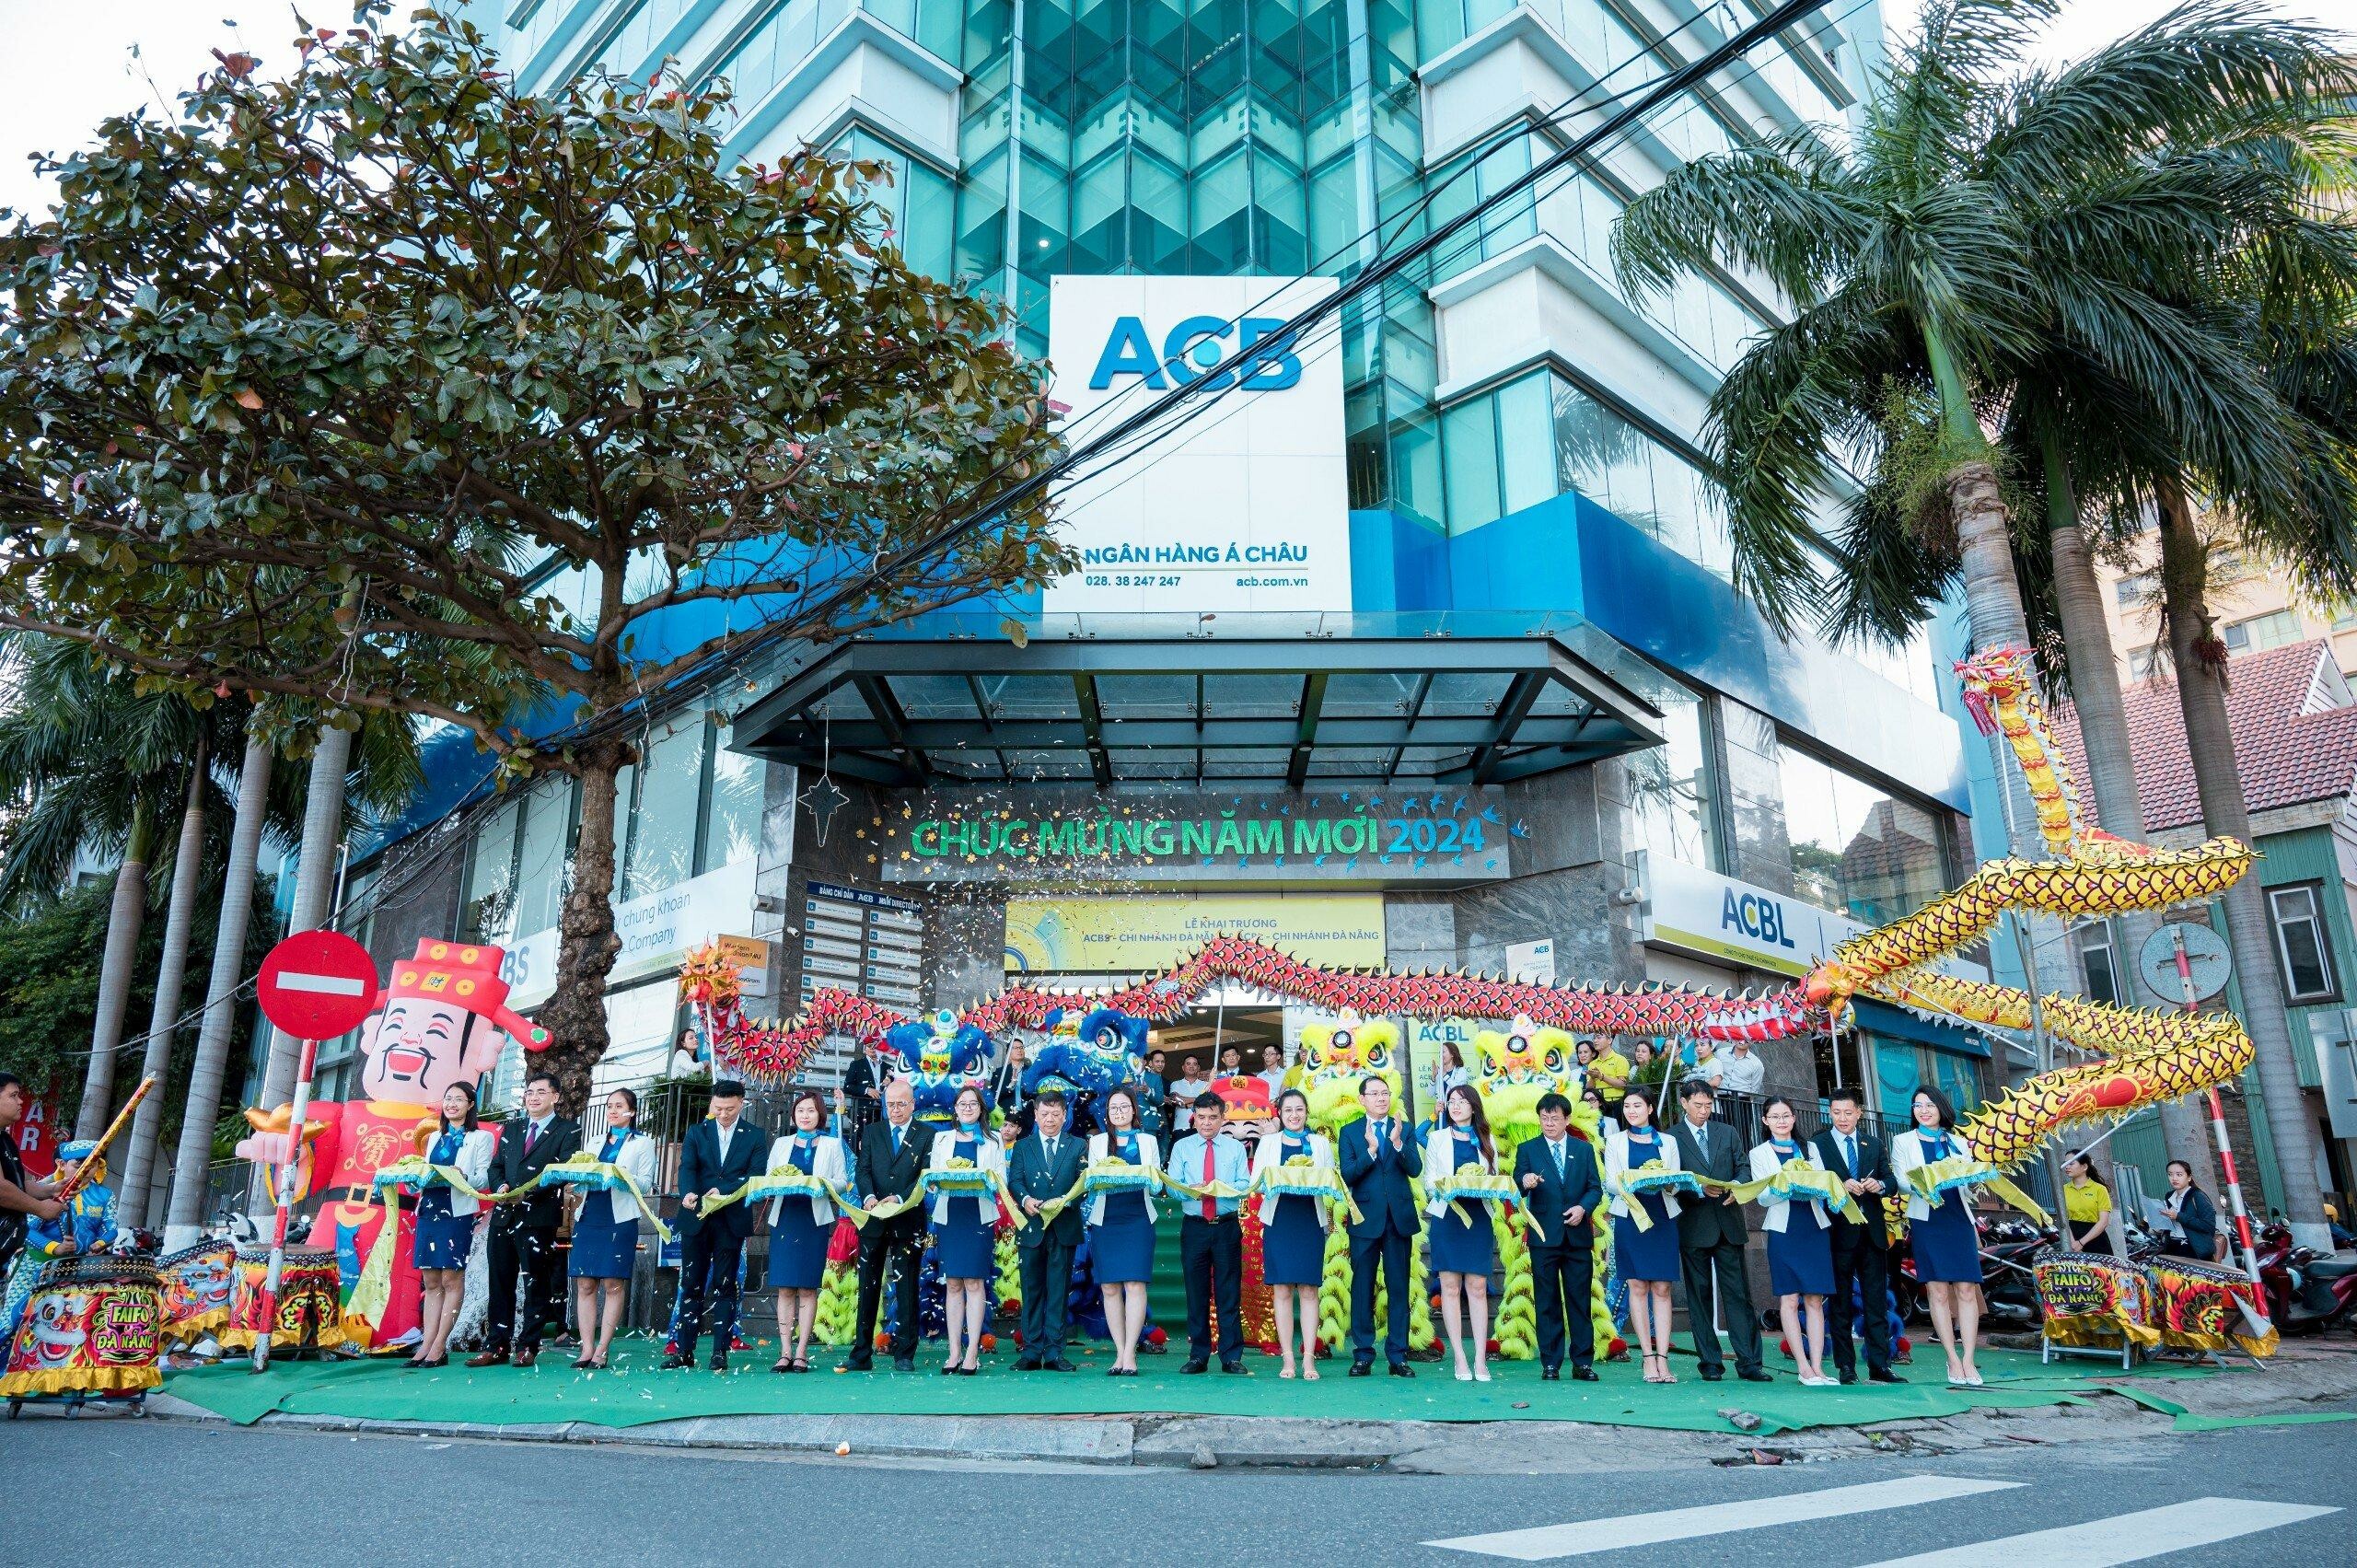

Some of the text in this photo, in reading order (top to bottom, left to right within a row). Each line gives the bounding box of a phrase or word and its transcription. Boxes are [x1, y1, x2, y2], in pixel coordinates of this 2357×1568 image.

[1088, 315, 1302, 391] ACB
[1085, 541, 1308, 564] NGÂN HÀNG Á CHÂU
[1086, 575, 1181, 587] 028. 38 247 247
[1236, 575, 1308, 587] acb.com.vn
[911, 805, 1486, 856] CHÚC MỪNG NĂM MỚI 2024
[656, 891, 691, 916] khoán
[857, 893, 874, 902] ACB
[1200, 920, 1226, 928] KHAI
[1229, 919, 1277, 928] TRƯƠNG
[1721, 886, 1795, 949] ACBL
[628, 926, 677, 952] Company
[1119, 933, 1137, 942] CHI
[1271, 932, 1290, 940] CHI
[1292, 930, 1330, 940] NHÁNH
[1332, 929, 1347, 940] ĐÀ
[1534, 945, 1550, 954] ACB
[503, 946, 530, 987] BS
[1419, 1025, 1469, 1041] ACBL
[2053, 1273, 2092, 1286] FAIFO
[112, 1306, 149, 1323] FAIFO
